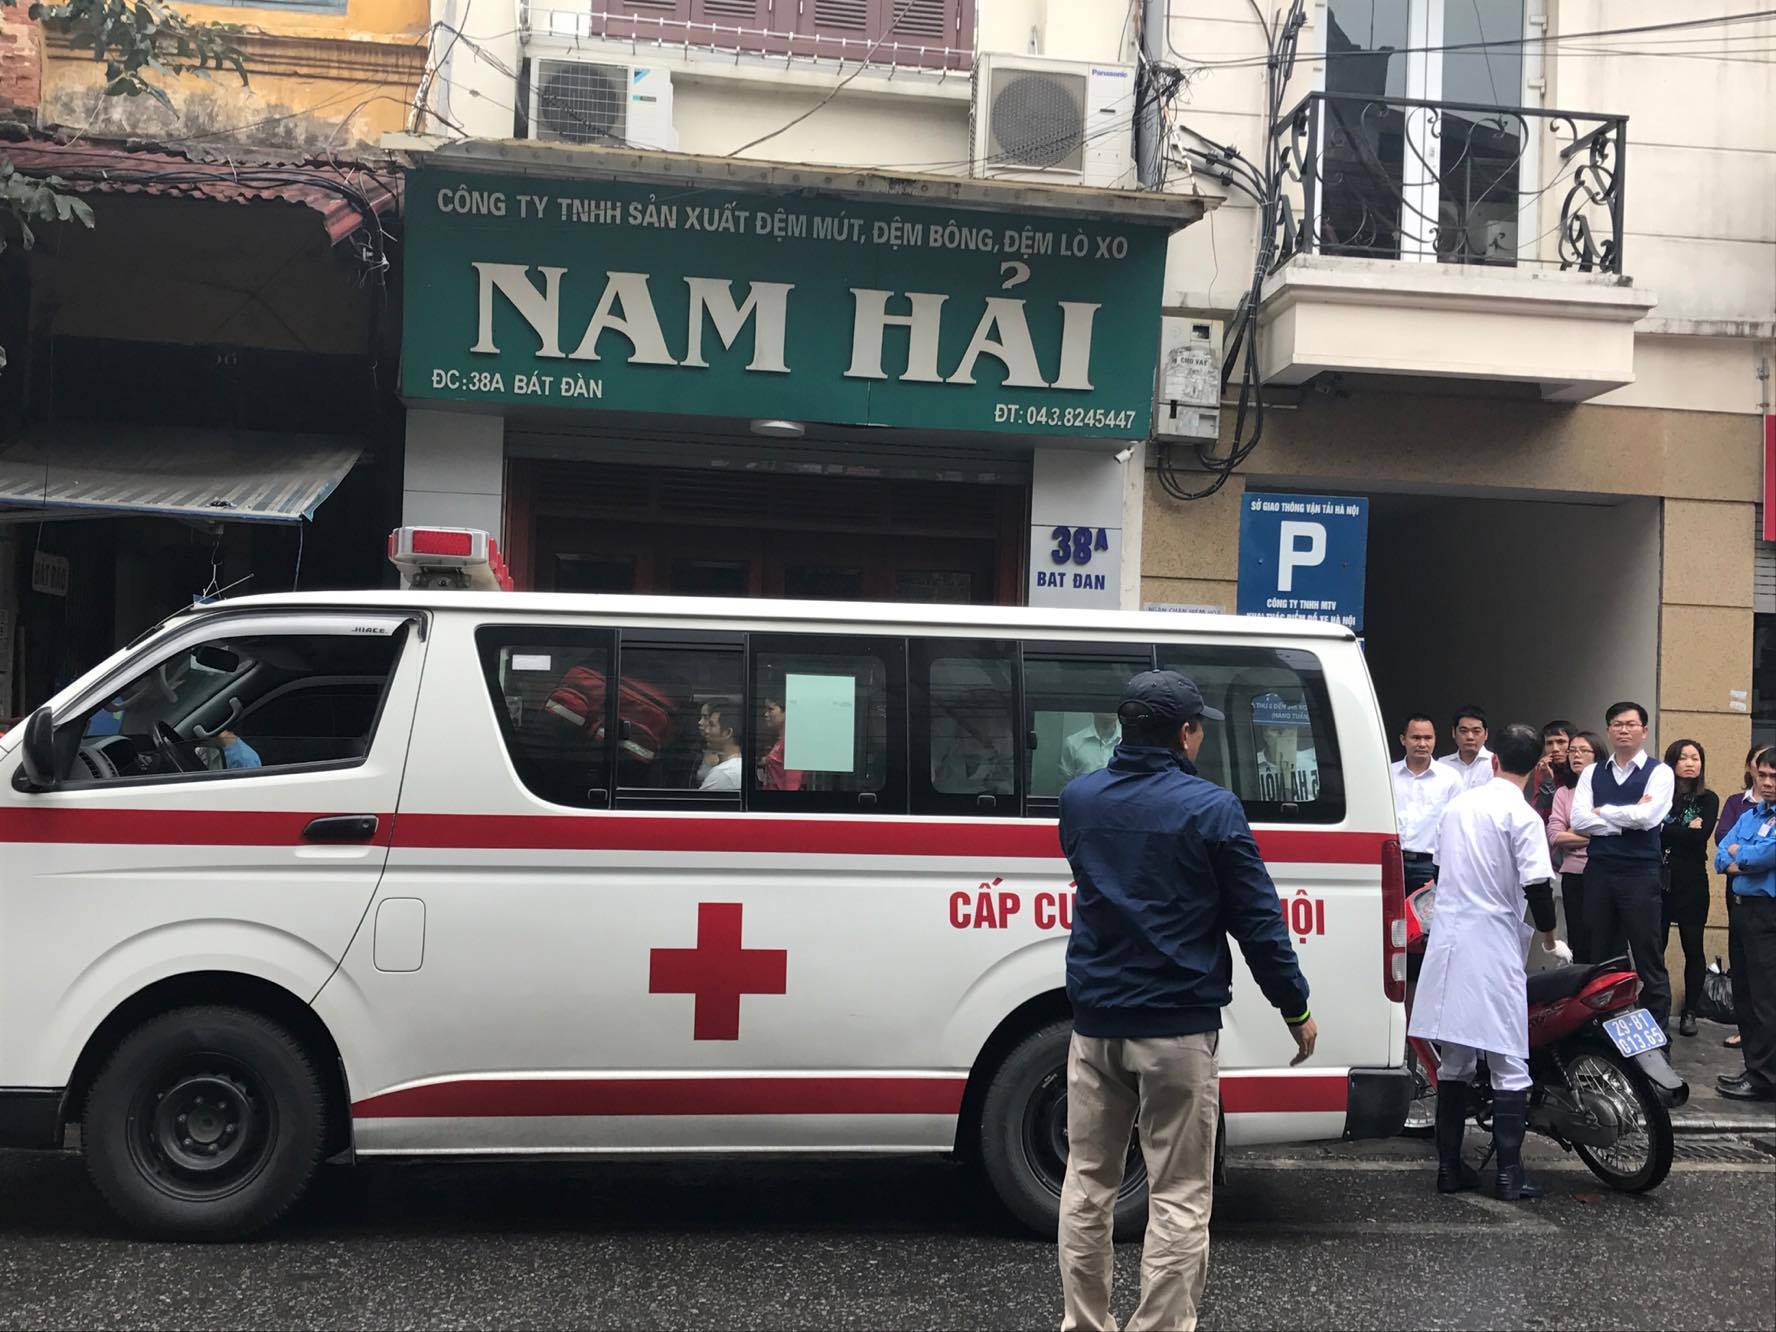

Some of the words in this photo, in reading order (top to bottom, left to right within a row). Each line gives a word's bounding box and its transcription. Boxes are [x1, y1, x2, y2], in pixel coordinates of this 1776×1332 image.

[437, 184, 506, 217] CÔNG
[516, 195, 548, 221] TY
[558, 198, 621, 225] TNHH
[628, 194, 677, 229] SẢN
[684, 201, 749, 234] XUẤT
[756, 208, 807, 242] ĐỆM
[813, 211, 866, 244] MÚT,
[872, 216, 922, 250] ĐỆM
[928, 220, 999, 254] BÔNG,
[1003, 226, 1051, 259] ĐỆM
[1060, 229, 1088, 257] LÒ
[1095, 236, 1128, 260] XO
[470, 262, 795, 373] NAM
[844, 261, 1102, 391] HẢI
[432, 369, 505, 393] ĐC:38A
[513, 370, 554, 396] BÁT
[560, 373, 602, 399] ĐÀN
[1027, 406, 1136, 430] 043.8245447
[1251, 498, 1262, 511] SỞ
[1262, 501, 1279, 512] GIAO
[1281, 501, 1304, 513] THÔNG
[1306, 502, 1321, 515] VẬN
[1322, 501, 1333, 514] TẢI
[1335, 503, 1344, 514] HÀ
[1346, 504, 1360, 517] NỘI
[1051, 526, 1109, 566] 38A
[1277, 520, 1327, 592] P
[1037, 571, 1066, 588] BAT
[1266, 597, 1288, 609] CÔNG
[1289, 599, 1299, 609] TY
[1300, 600, 1319, 610] TNHH
[1321, 601, 1337, 611] MTV
[1342, 614, 1356, 627] NỘI
[949, 877, 1021, 929] CẤP
[1612, 1012, 1649, 1038] 29-B1
